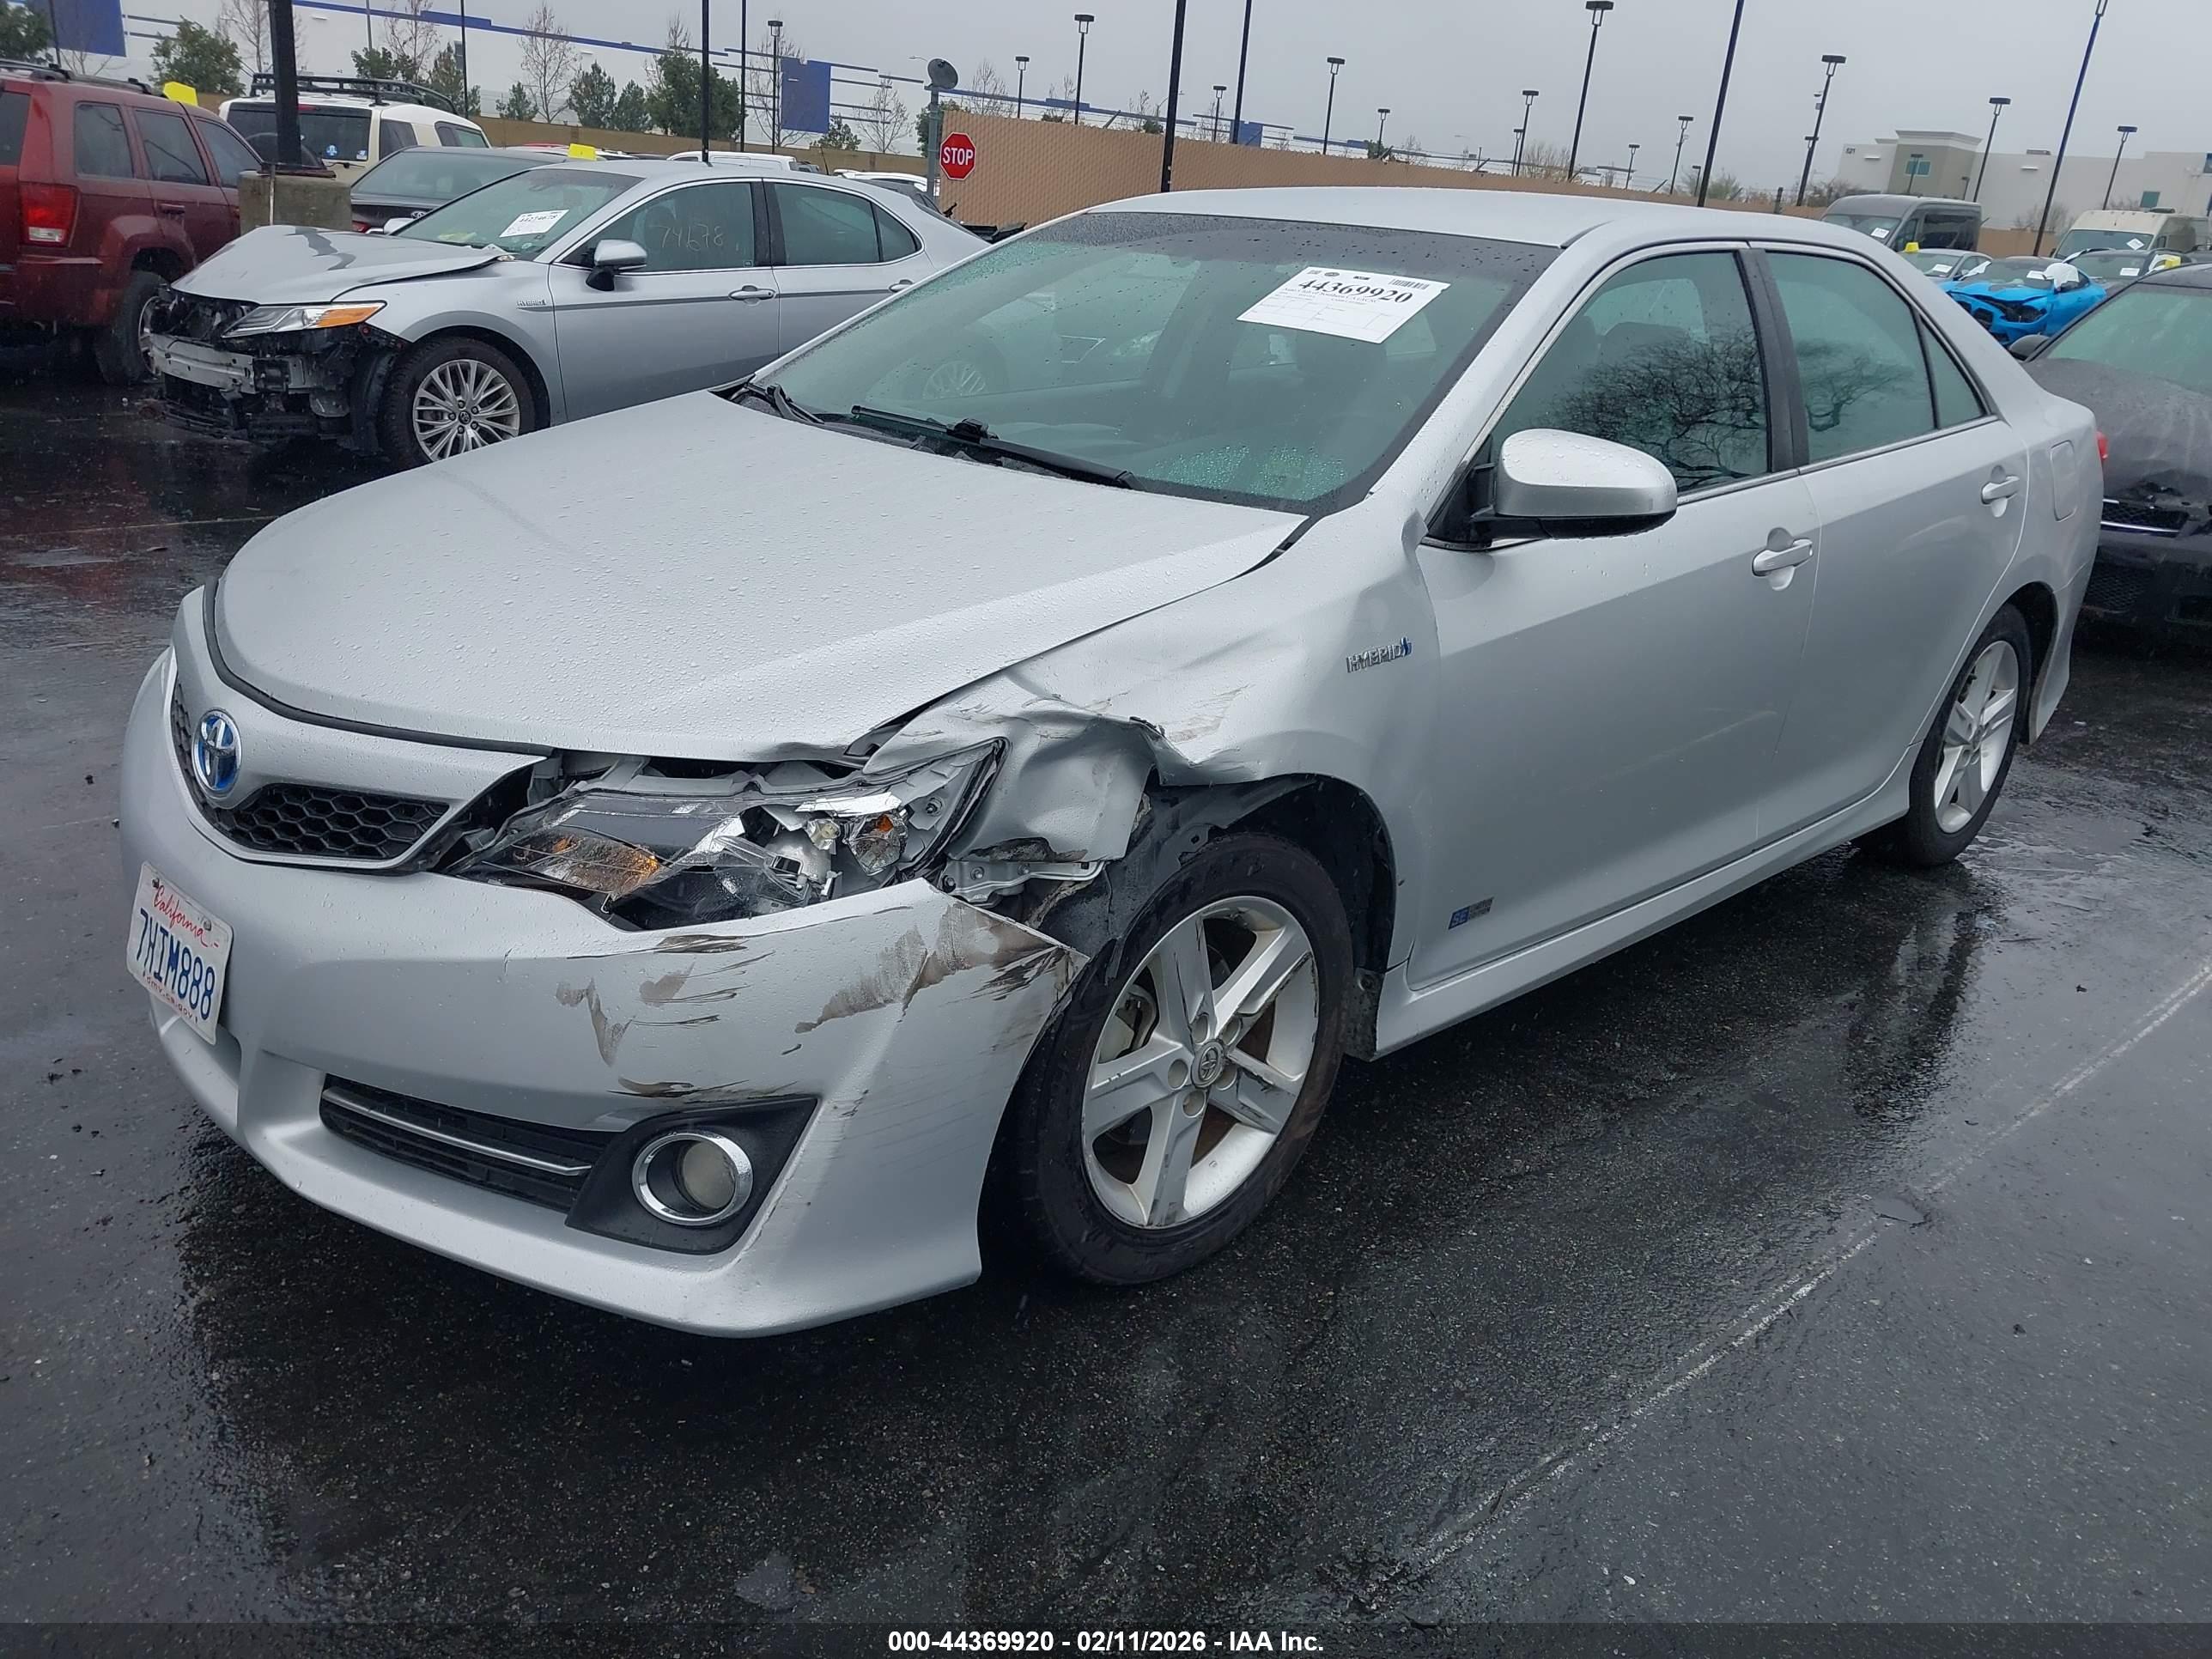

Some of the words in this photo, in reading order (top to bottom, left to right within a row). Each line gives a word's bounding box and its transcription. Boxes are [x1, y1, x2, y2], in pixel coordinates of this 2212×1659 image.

[942, 146, 974, 166] STOP
[649, 222, 723, 252] 74678
[1299, 279, 1413, 303] 44369920
[1346, 644, 1402, 673] HYBRID
[153, 884, 209, 947] California
[136, 908, 216, 1020] 7HIM888
[146, 975, 193, 1019] dmv.ca.gov
